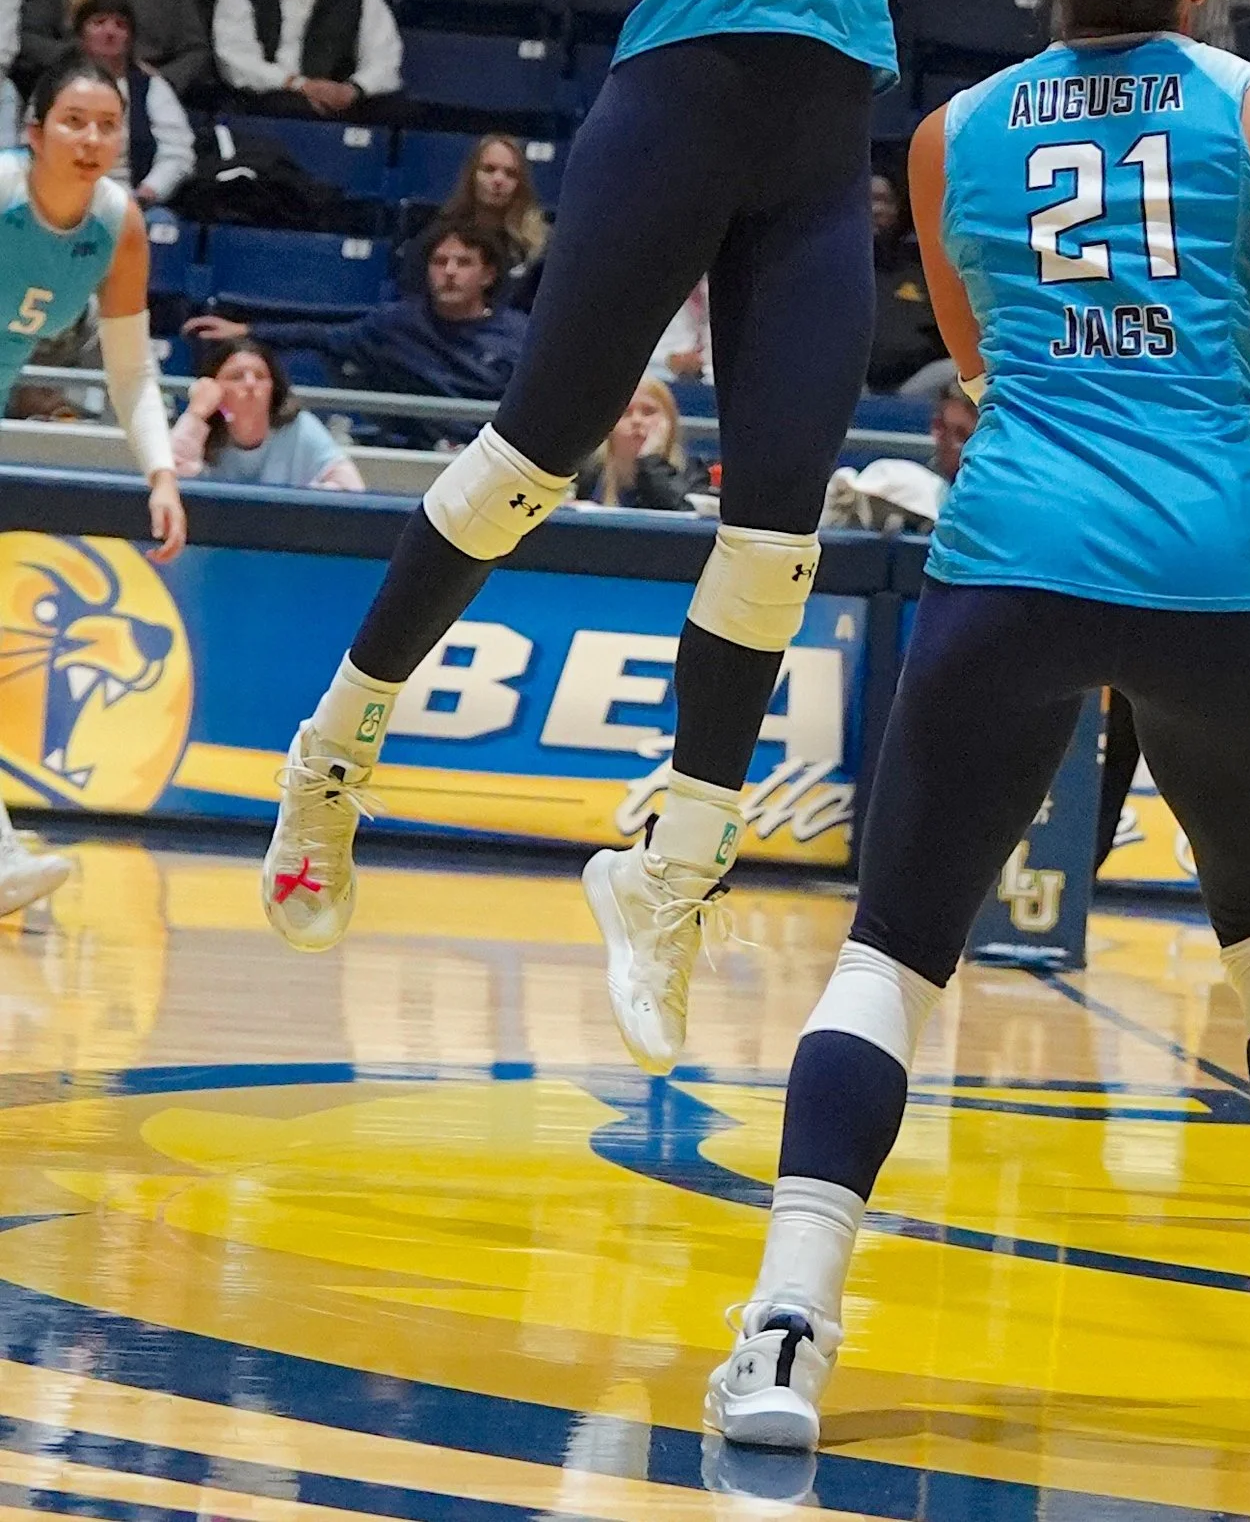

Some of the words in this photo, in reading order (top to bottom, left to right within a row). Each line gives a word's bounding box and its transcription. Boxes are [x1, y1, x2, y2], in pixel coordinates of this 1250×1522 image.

[1007, 74, 1183, 130] AUGUSTA
[1025, 130, 1180, 285] 21
[8, 286, 53, 335] 5
[1050, 304, 1177, 359] JAGS
